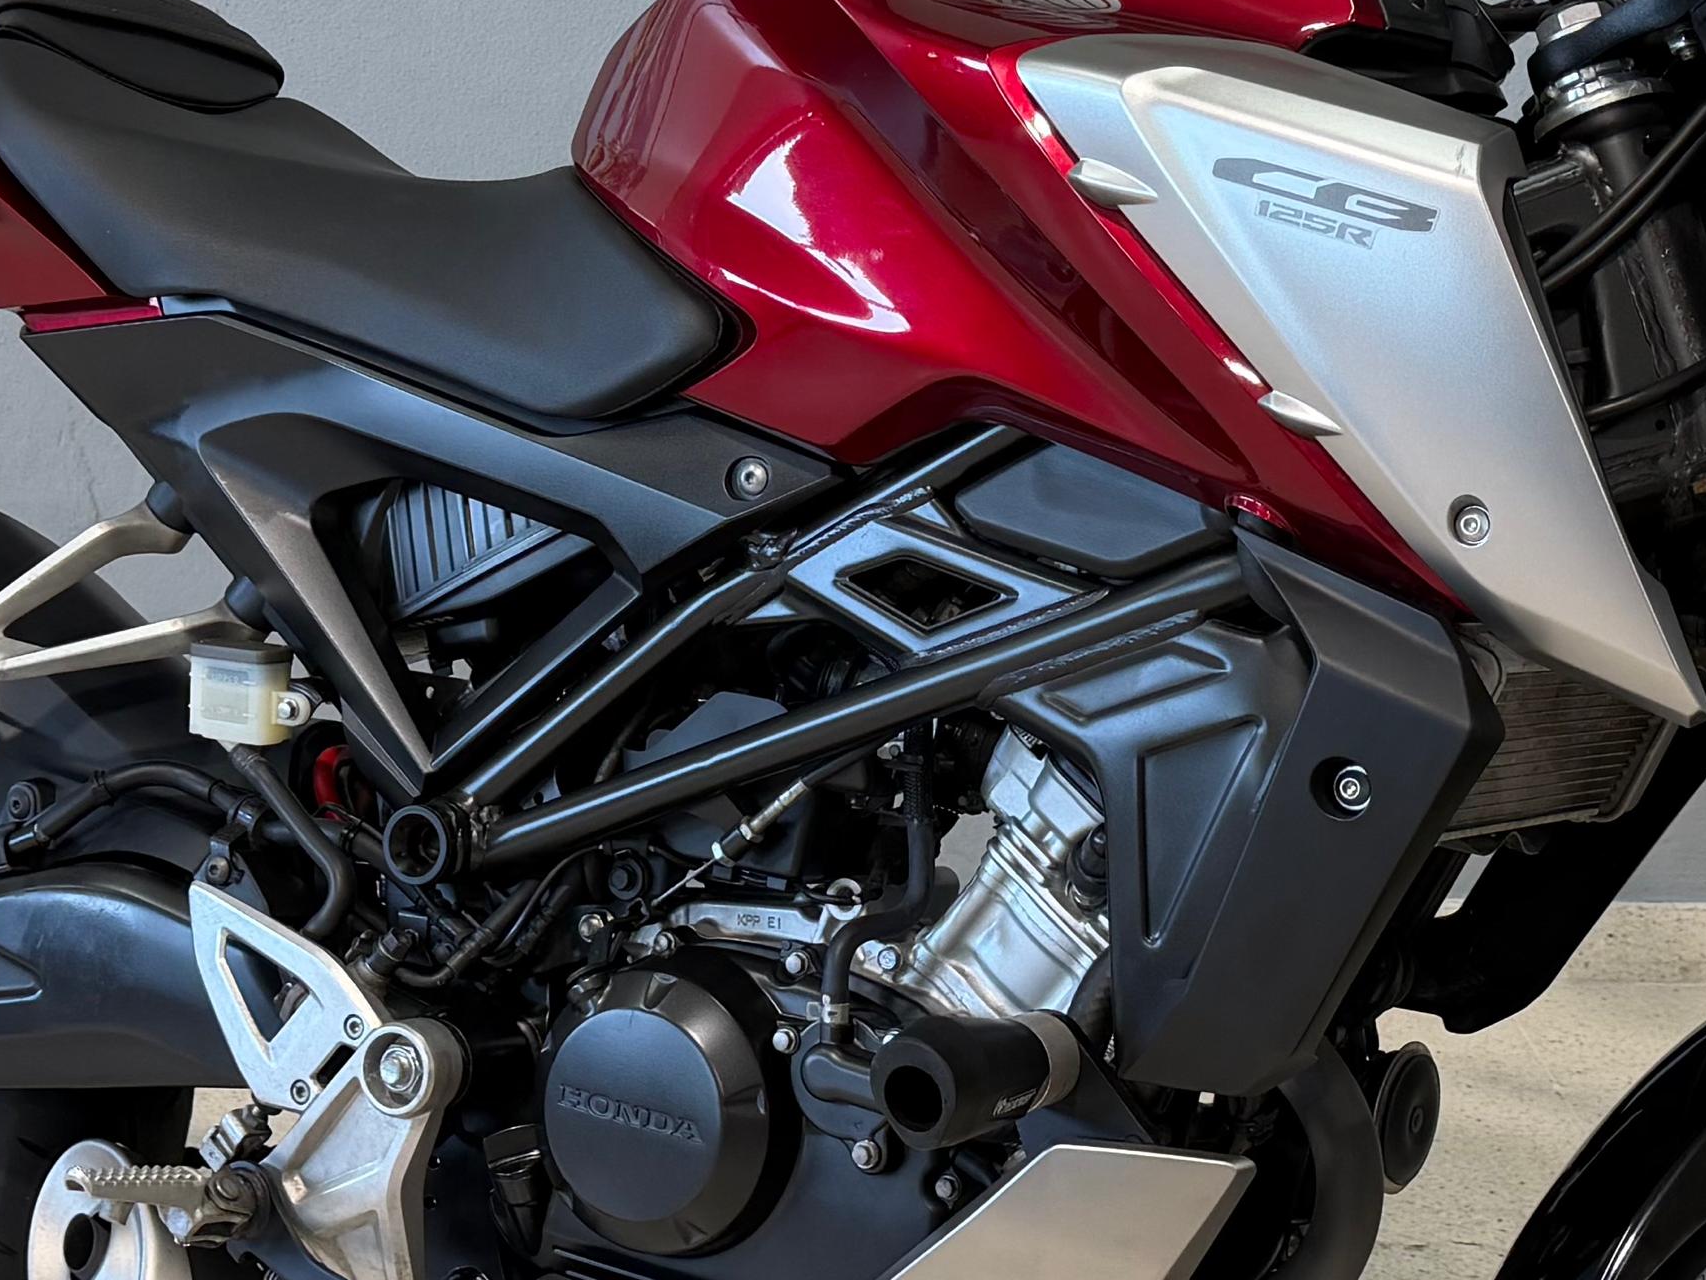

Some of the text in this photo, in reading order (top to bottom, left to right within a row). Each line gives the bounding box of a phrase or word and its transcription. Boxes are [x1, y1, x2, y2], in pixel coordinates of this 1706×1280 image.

[1212, 157, 1439, 234] CB
[1257, 199, 1376, 251] 125R
[557, 1083, 705, 1146] HONDA
